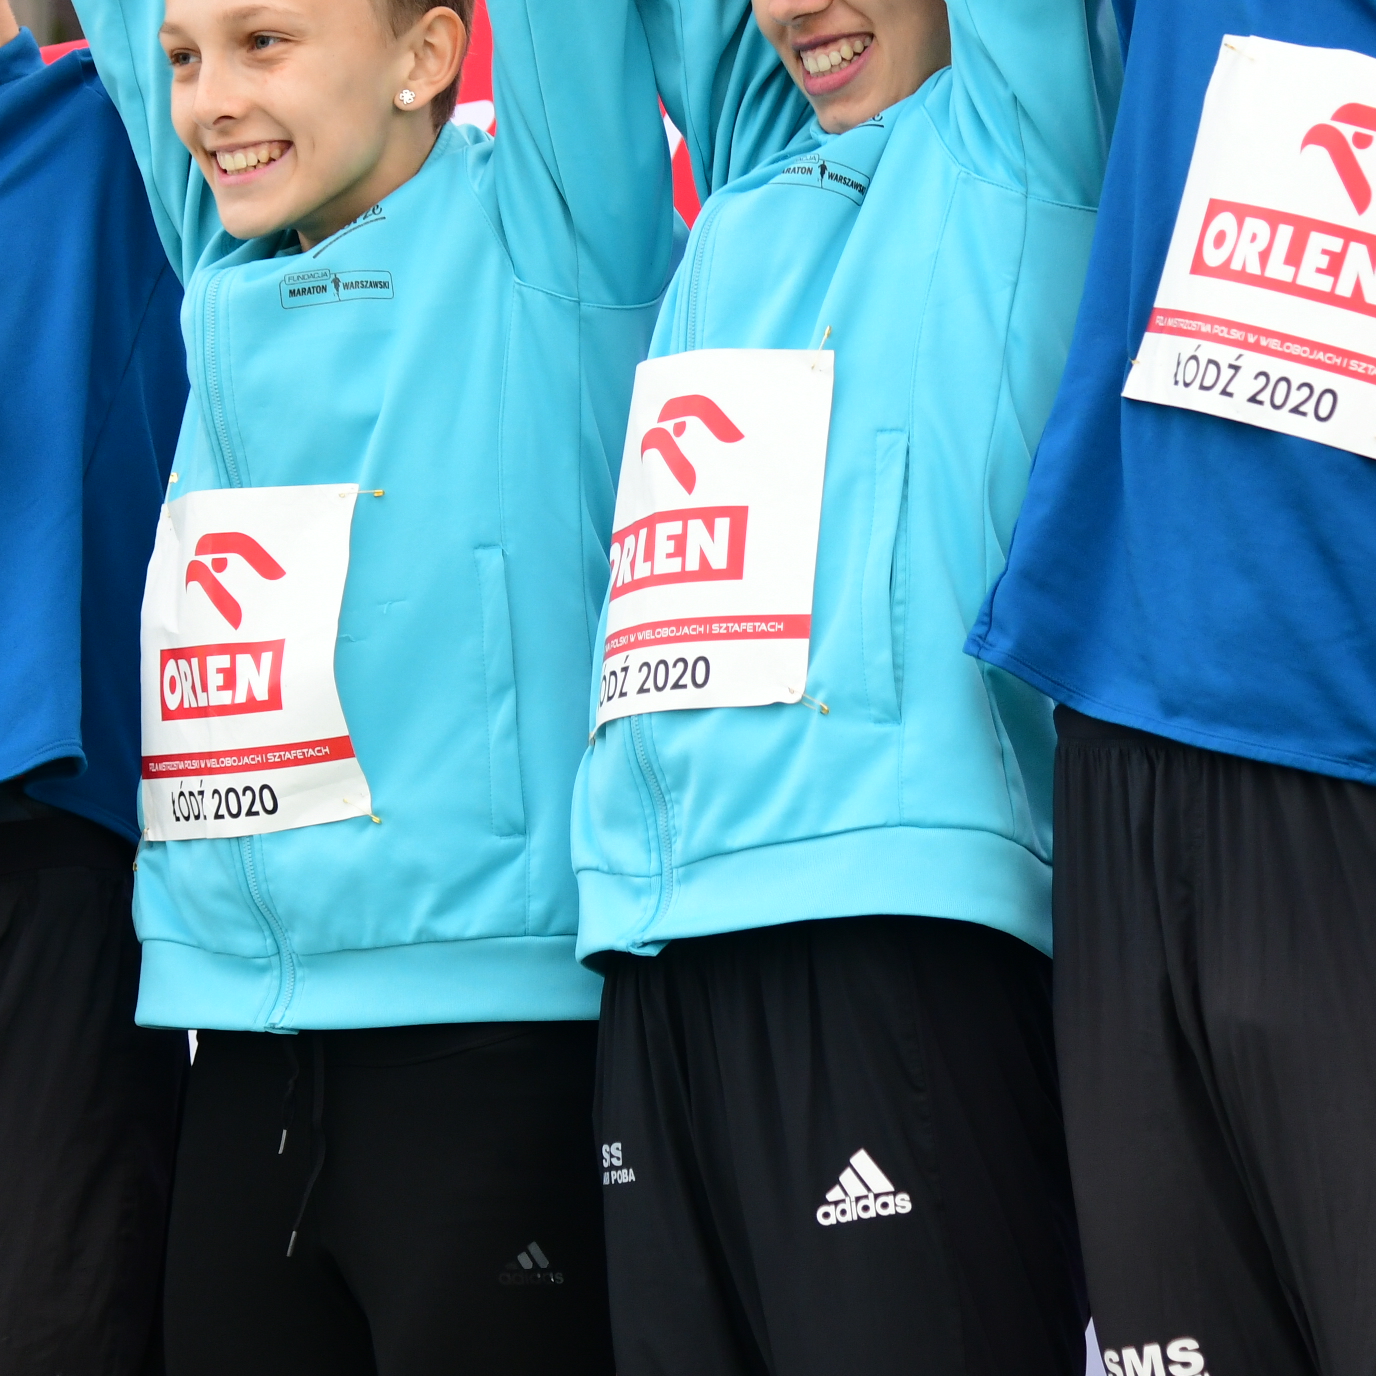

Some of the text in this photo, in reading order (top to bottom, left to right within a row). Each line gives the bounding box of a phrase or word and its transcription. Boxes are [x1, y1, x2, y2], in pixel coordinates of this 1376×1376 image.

[782, 166, 867, 196] ARATON WARSZAWSK
[288, 270, 329, 283] FUNDACJA
[288, 281, 390, 298] MARATON WARSZAWSKI
[1212, 325, 1245, 341] POLSKI
[1247, 333, 1259, 343] W
[1259, 336, 1342, 366] WIELOBOJACH
[1173, 344, 1339, 423] ŁÓDŹ 2020
[637, 624, 704, 641] WIELOBOJACH
[712, 622, 784, 634] SZTAFETACH
[162, 650, 273, 711] ORLEN
[599, 655, 711, 711] ÓDŹ 2020
[206, 754, 262, 769] WIELOBOJACH
[267, 746, 330, 763] SZTAFETACH
[171, 779, 279, 822] ŁÓDŹ 2020
[816, 1193, 912, 1226] adidas
